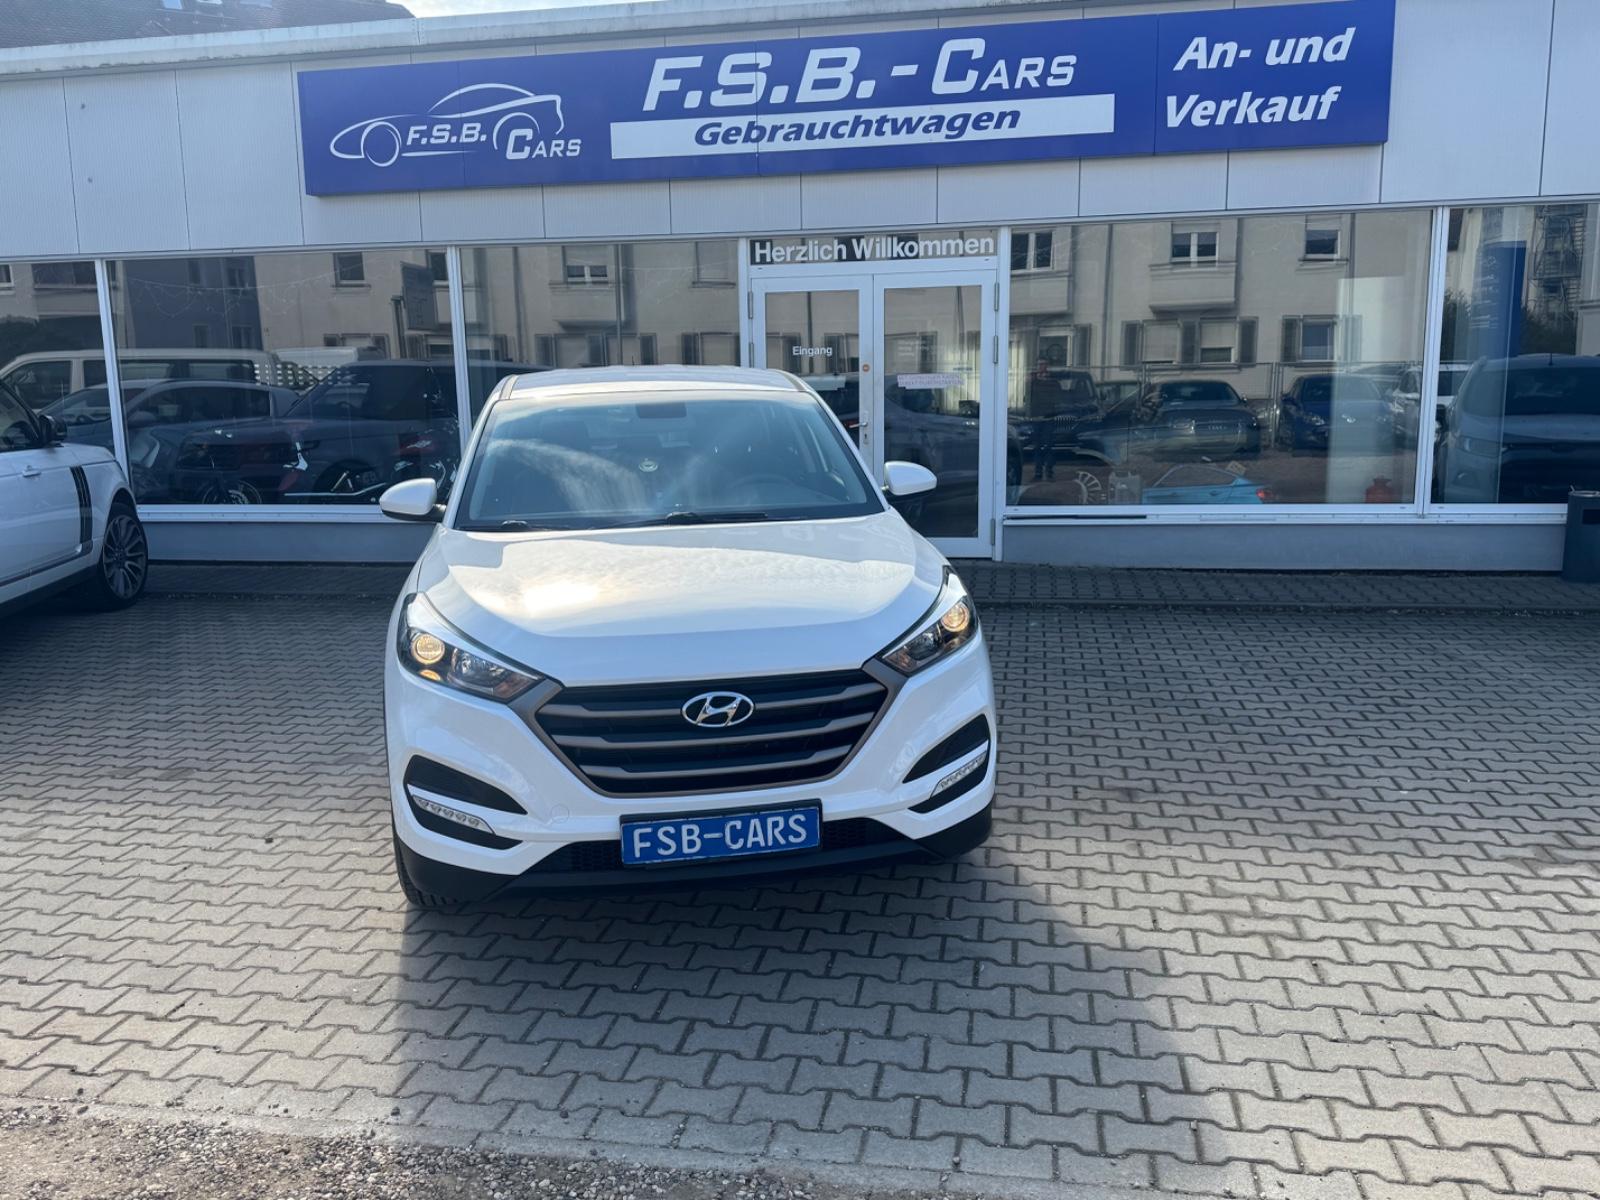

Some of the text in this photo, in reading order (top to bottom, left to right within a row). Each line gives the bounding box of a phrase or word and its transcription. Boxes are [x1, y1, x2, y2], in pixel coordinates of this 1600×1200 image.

[1173, 28, 1356, 71] An- und
[694, 107, 1020, 146] Gebrauchtwagen
[1165, 86, 1341, 128] Verkauf
[754, 237, 994, 263] Herzlich Willkommen
[792, 345, 833, 357] Eingang
[633, 814, 807, 858] FSB-CARS
